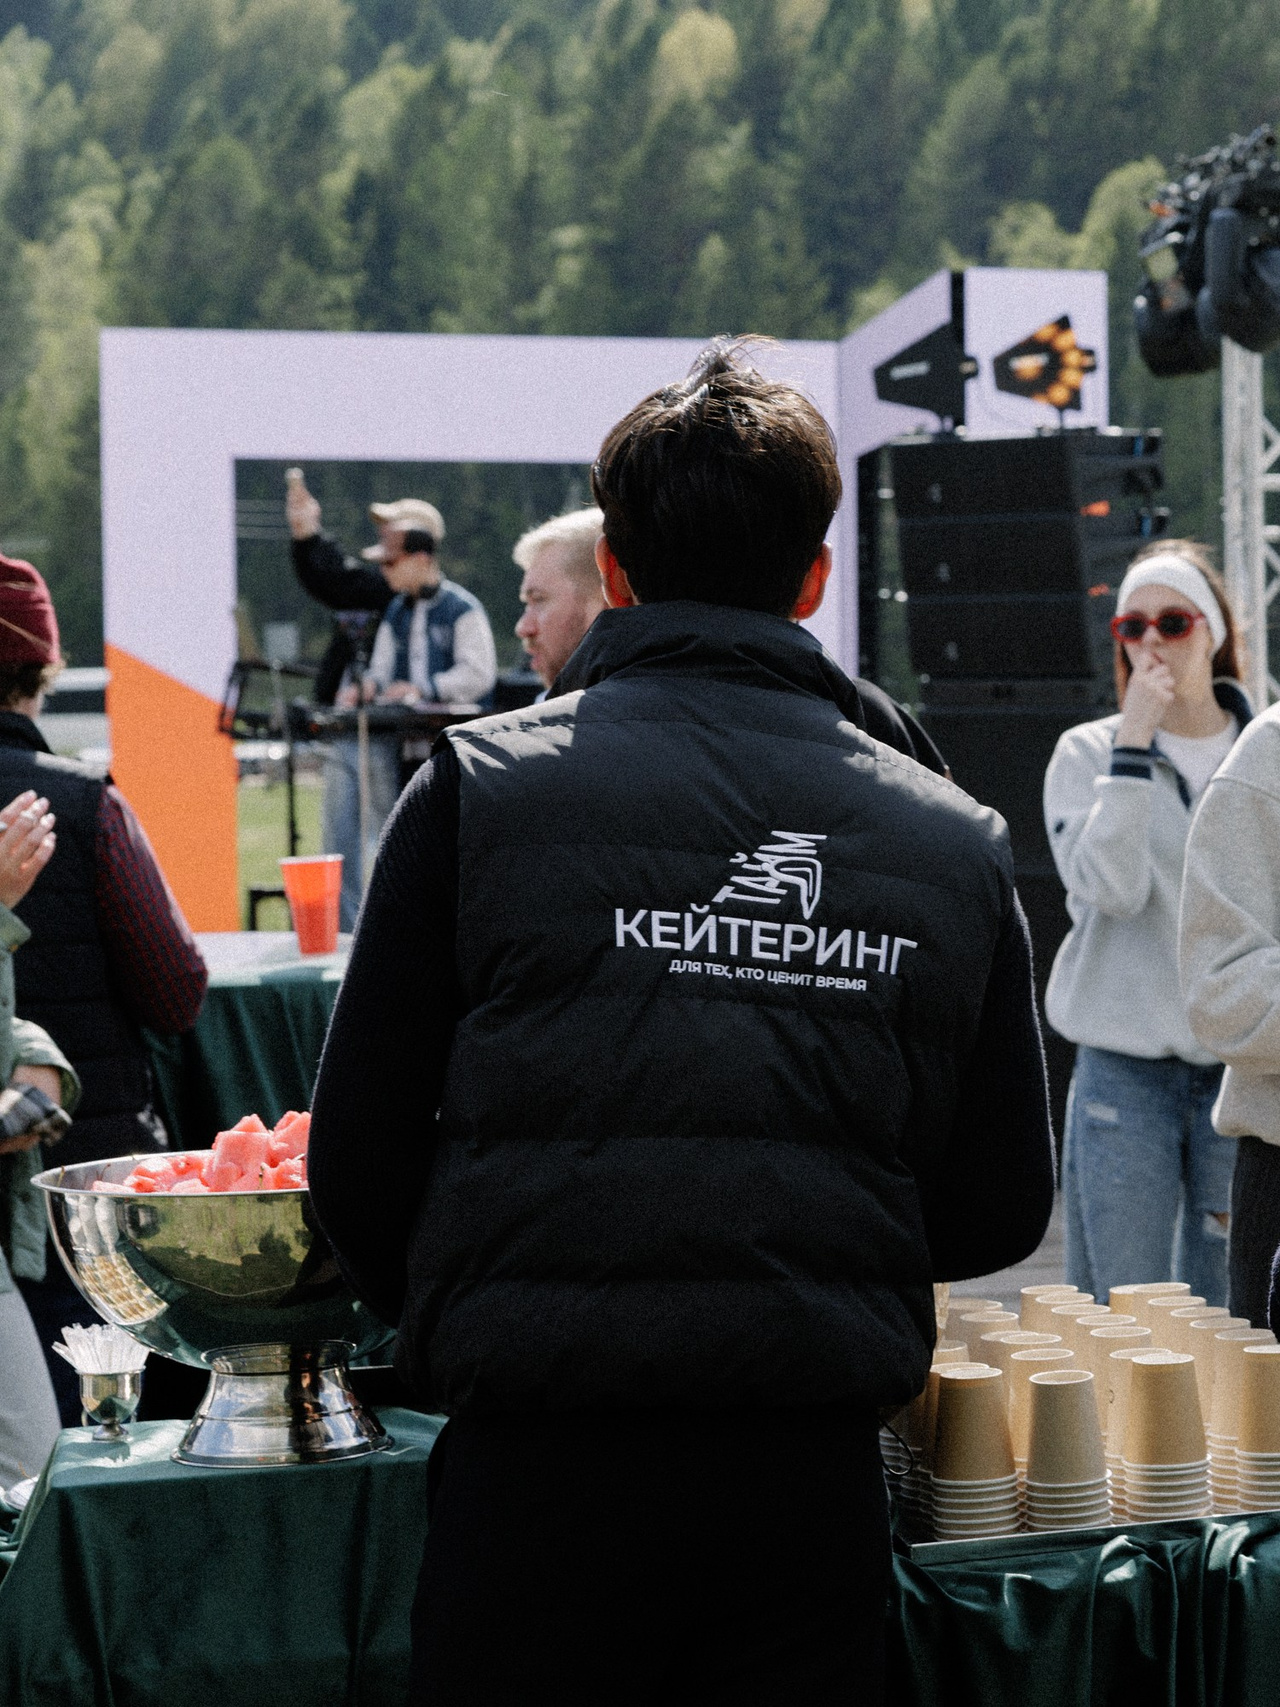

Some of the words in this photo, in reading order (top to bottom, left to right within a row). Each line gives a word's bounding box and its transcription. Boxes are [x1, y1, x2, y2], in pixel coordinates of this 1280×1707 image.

[614, 902, 919, 976] КЕЙТЕРИНГ
[668, 959, 702, 974] ДЛЯ
[703, 962, 734, 979] ТЕХ,
[735, 966, 765, 981] КТО
[767, 969, 814, 987] ЦЕНИТ
[815, 975, 867, 992] ВРЕМЯ
